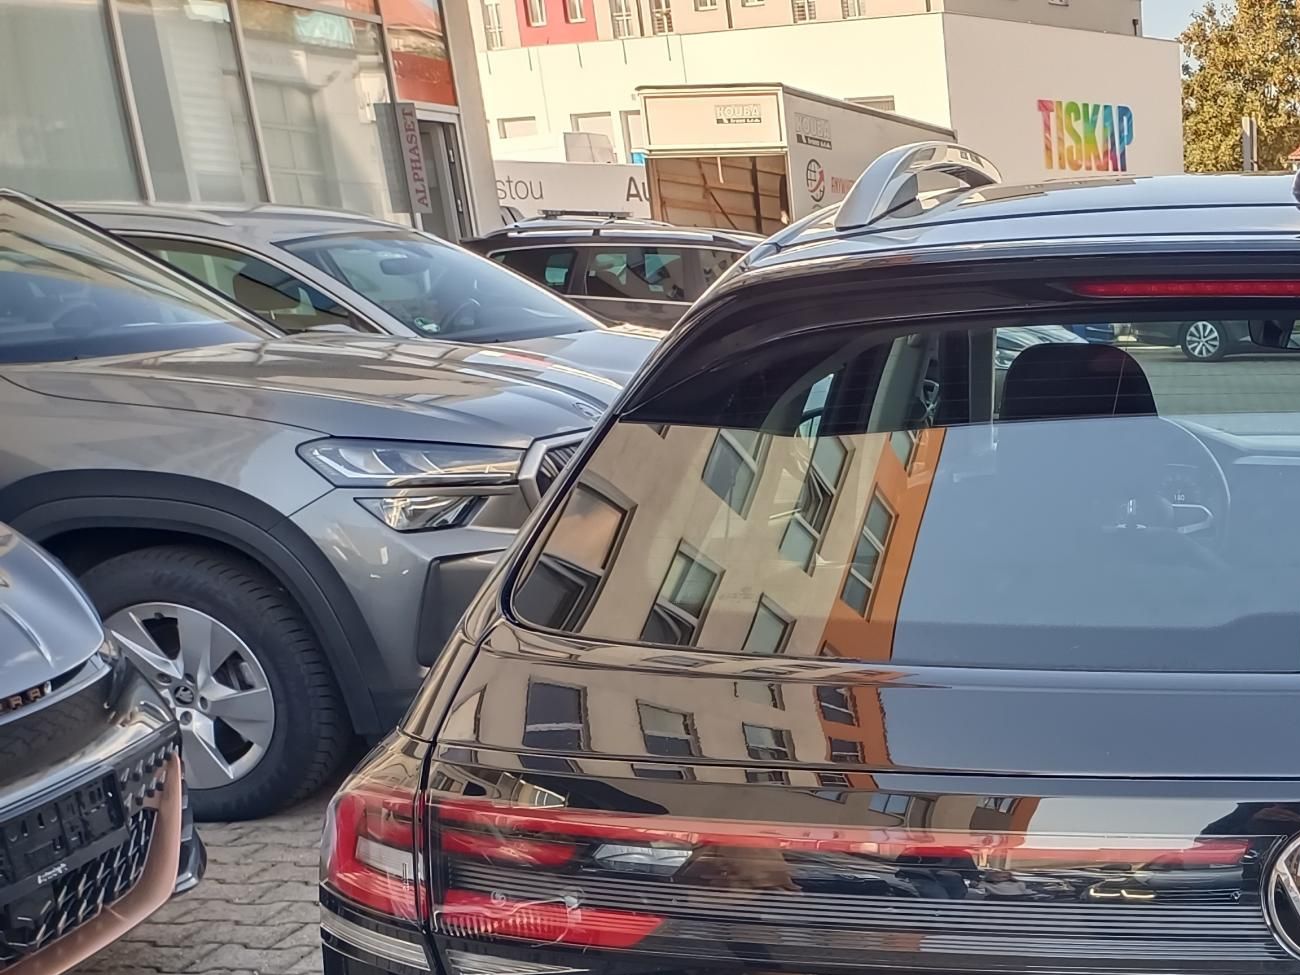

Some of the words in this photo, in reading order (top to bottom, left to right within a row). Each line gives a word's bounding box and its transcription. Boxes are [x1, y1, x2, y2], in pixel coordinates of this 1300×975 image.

[714, 105, 761, 119] KOUBA
[1037, 99, 1134, 172] TISKAP
[402, 108, 429, 207] ALPHASET
